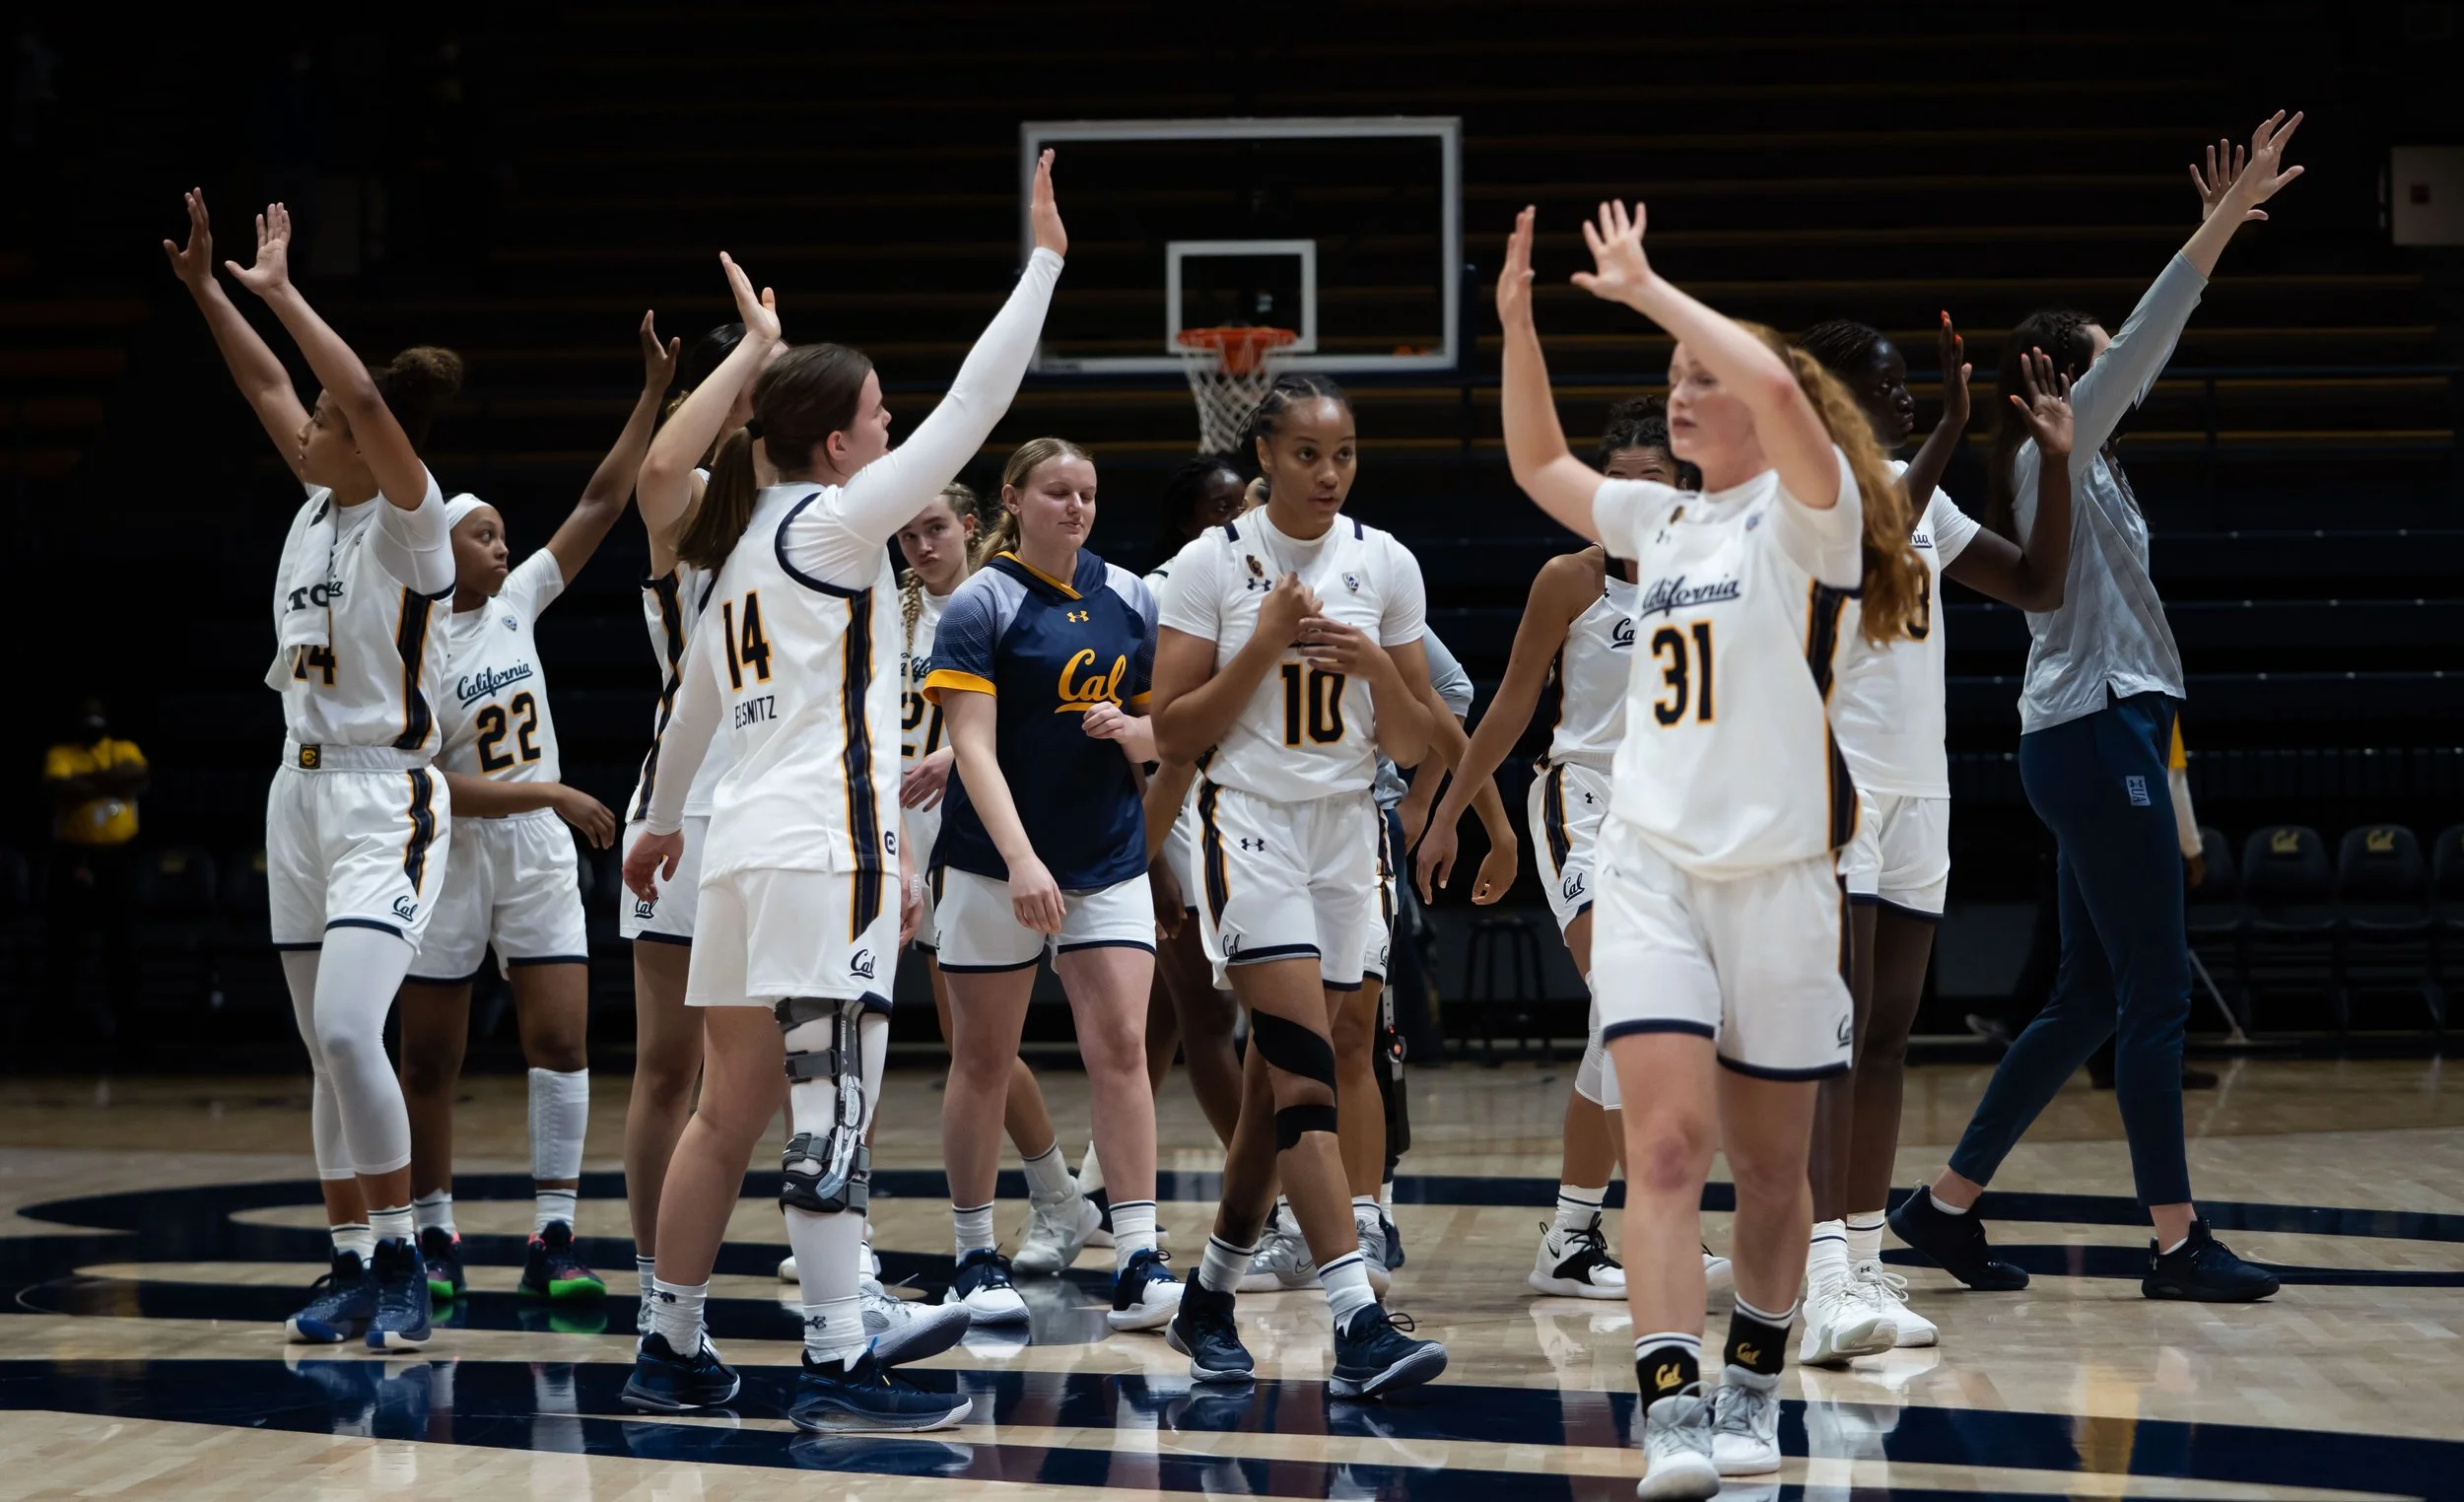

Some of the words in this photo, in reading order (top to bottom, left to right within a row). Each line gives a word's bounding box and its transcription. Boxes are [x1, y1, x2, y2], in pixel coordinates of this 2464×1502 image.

[723, 589, 772, 693] 14
[1610, 617, 1636, 649] Ca
[456, 659, 534, 710] California
[1055, 649, 1127, 714] Cal
[1652, 618, 1715, 728] 31
[1279, 662, 1346, 747] 10
[475, 690, 542, 776] 22
[391, 895, 419, 922] Cal
[1562, 871, 1586, 905] Cal
[850, 948, 876, 980] Cal
[1736, 1342, 1761, 1365] Cal
[1656, 1363, 1683, 1392] Cal
